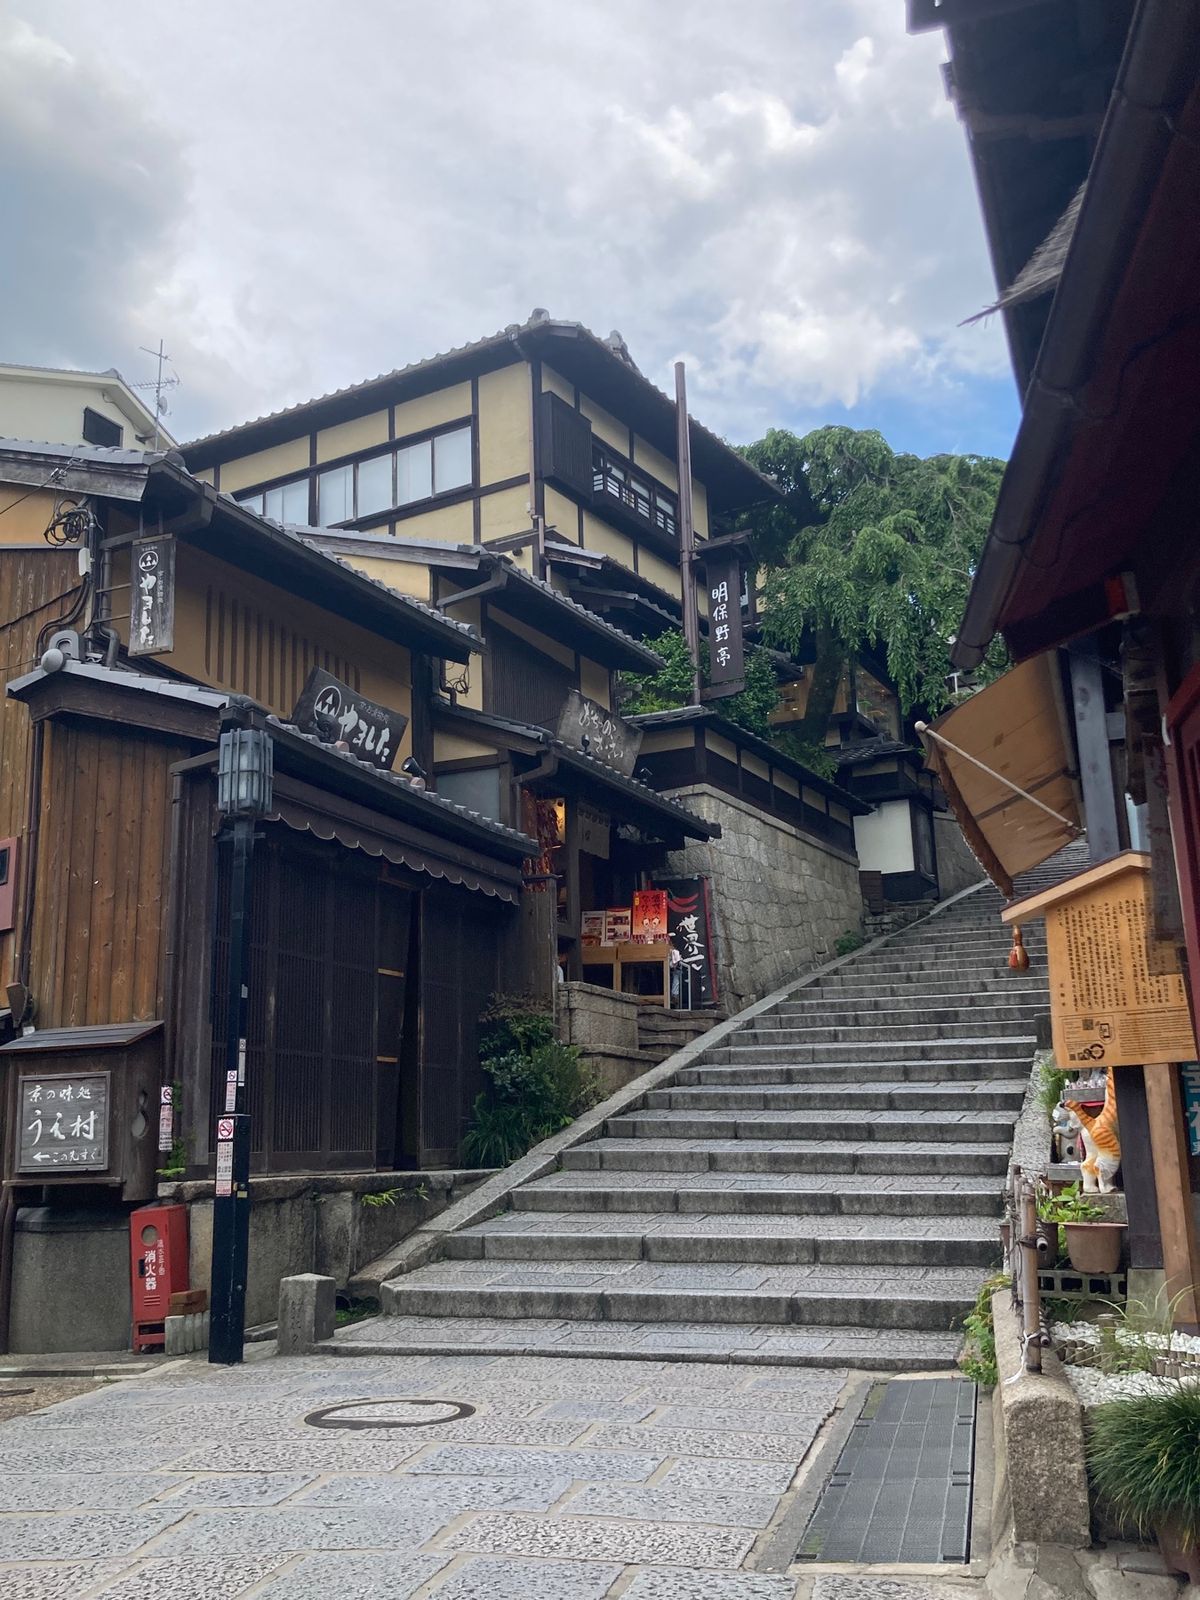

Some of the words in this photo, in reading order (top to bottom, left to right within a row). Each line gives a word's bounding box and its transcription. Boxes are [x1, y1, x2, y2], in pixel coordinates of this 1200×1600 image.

[711, 581, 731, 667] 明保野亭
[27, 1084, 92, 1103] 京の味処
[27, 1109, 99, 1146] うえ村
[144, 1249, 157, 1291] 消火器
